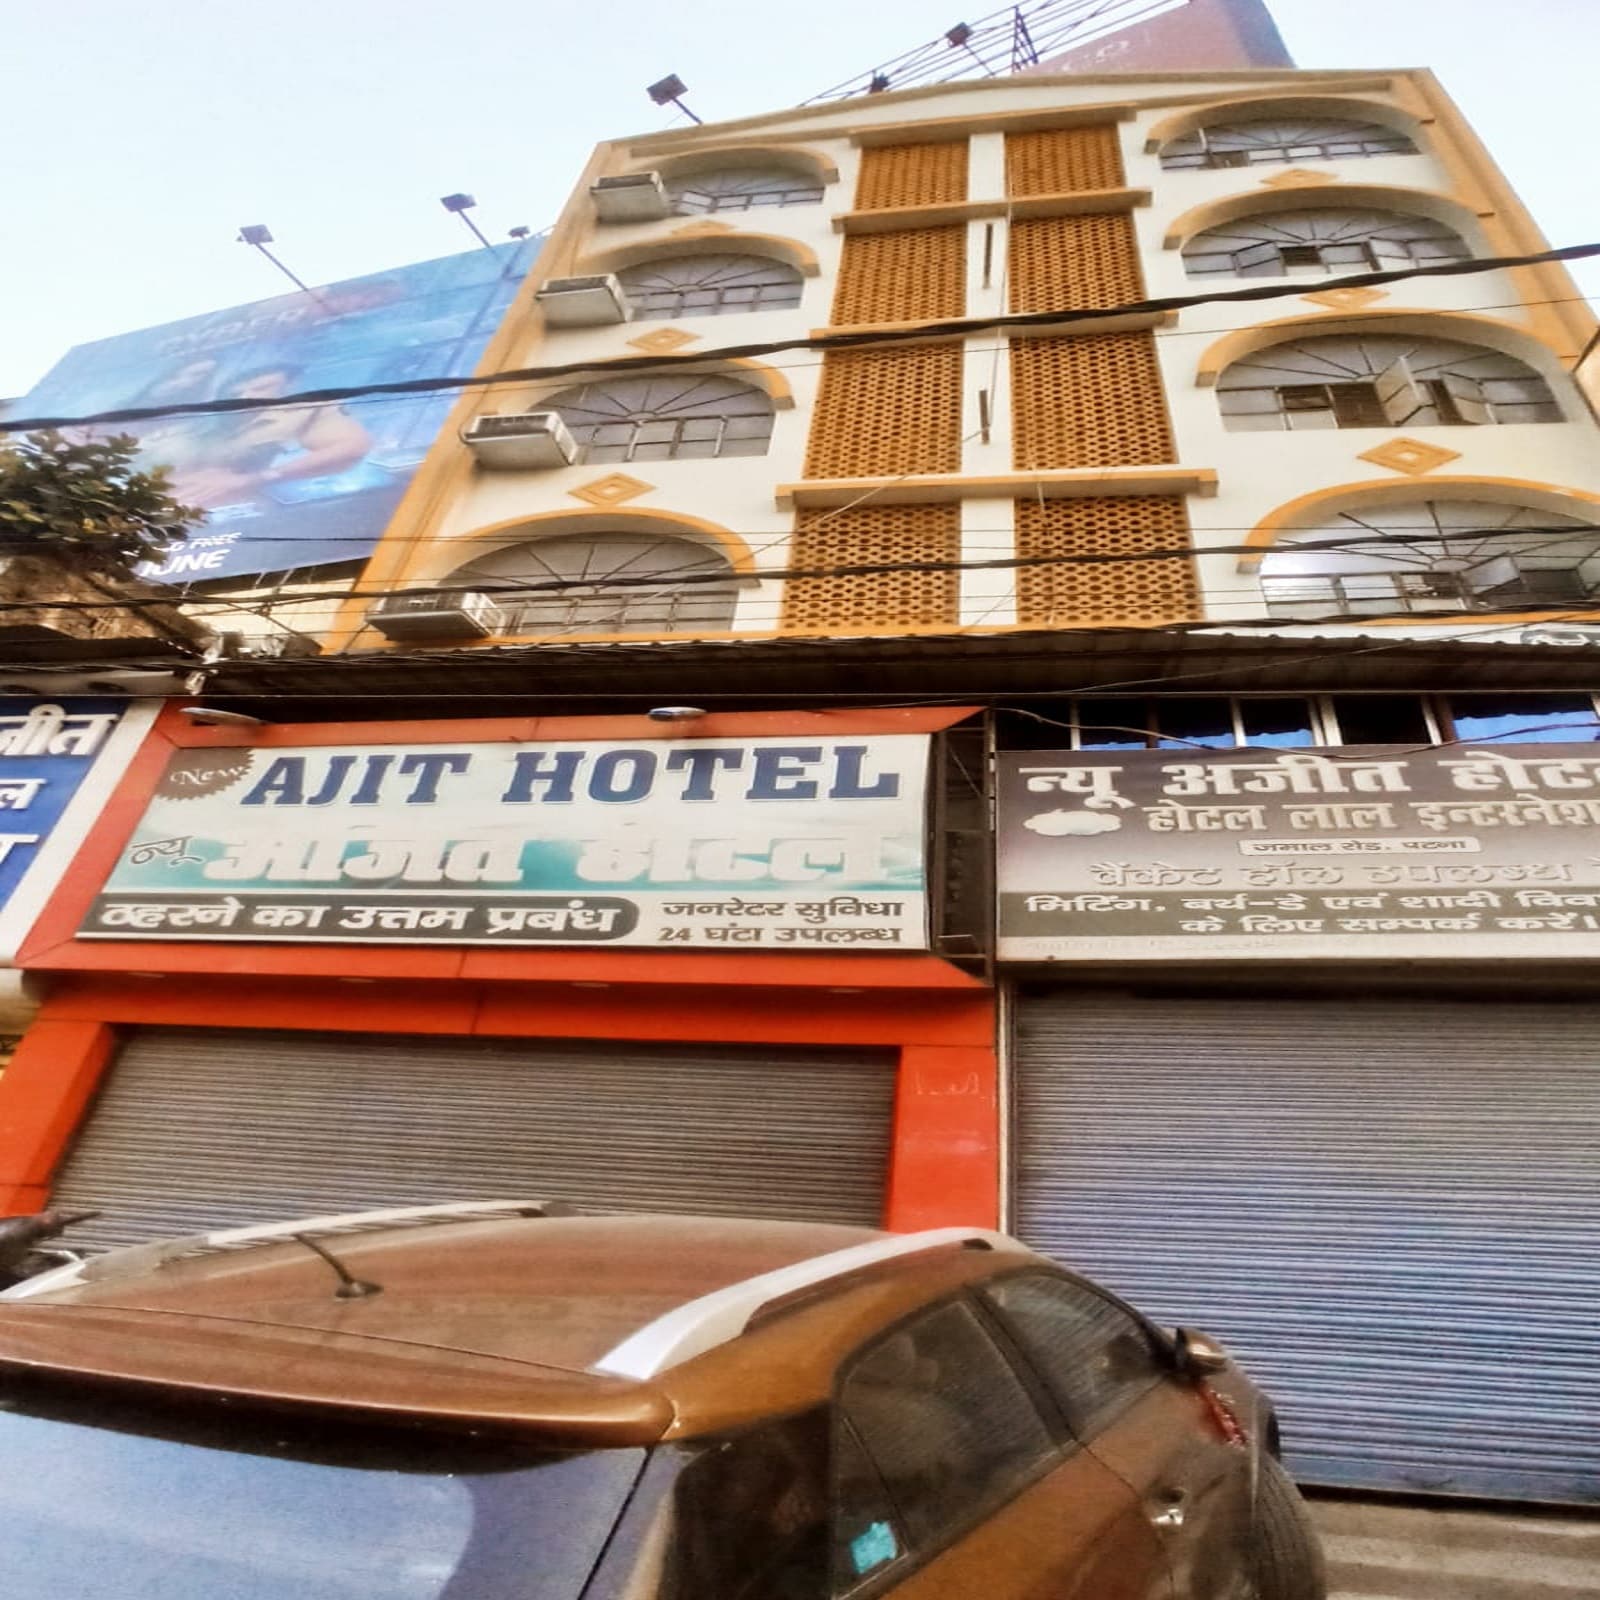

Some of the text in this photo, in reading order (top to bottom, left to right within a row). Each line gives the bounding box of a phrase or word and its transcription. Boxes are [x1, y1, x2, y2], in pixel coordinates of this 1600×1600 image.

[170, 766, 243, 785] New
[240, 745, 900, 806] AJIT HOTEL
[1019, 751, 1600, 808] न्यू अजीत होट
[1142, 799, 1267, 831] होटल
[1282, 803, 1397, 829] लाल
[663, 897, 904, 923] जनरेटर सुविधा
[1320, 892, 1389, 909] एवं
[1398, 890, 1502, 909] शादी
[101, 897, 621, 935] ठहरने का उत्तम प्रबंध
[1179, 915, 1227, 933] के
[1239, 914, 1325, 932] लिए
[1337, 912, 1482, 931] सम्पर्क
[658, 922, 902, 943] 24 घंटा उपलब्ध
